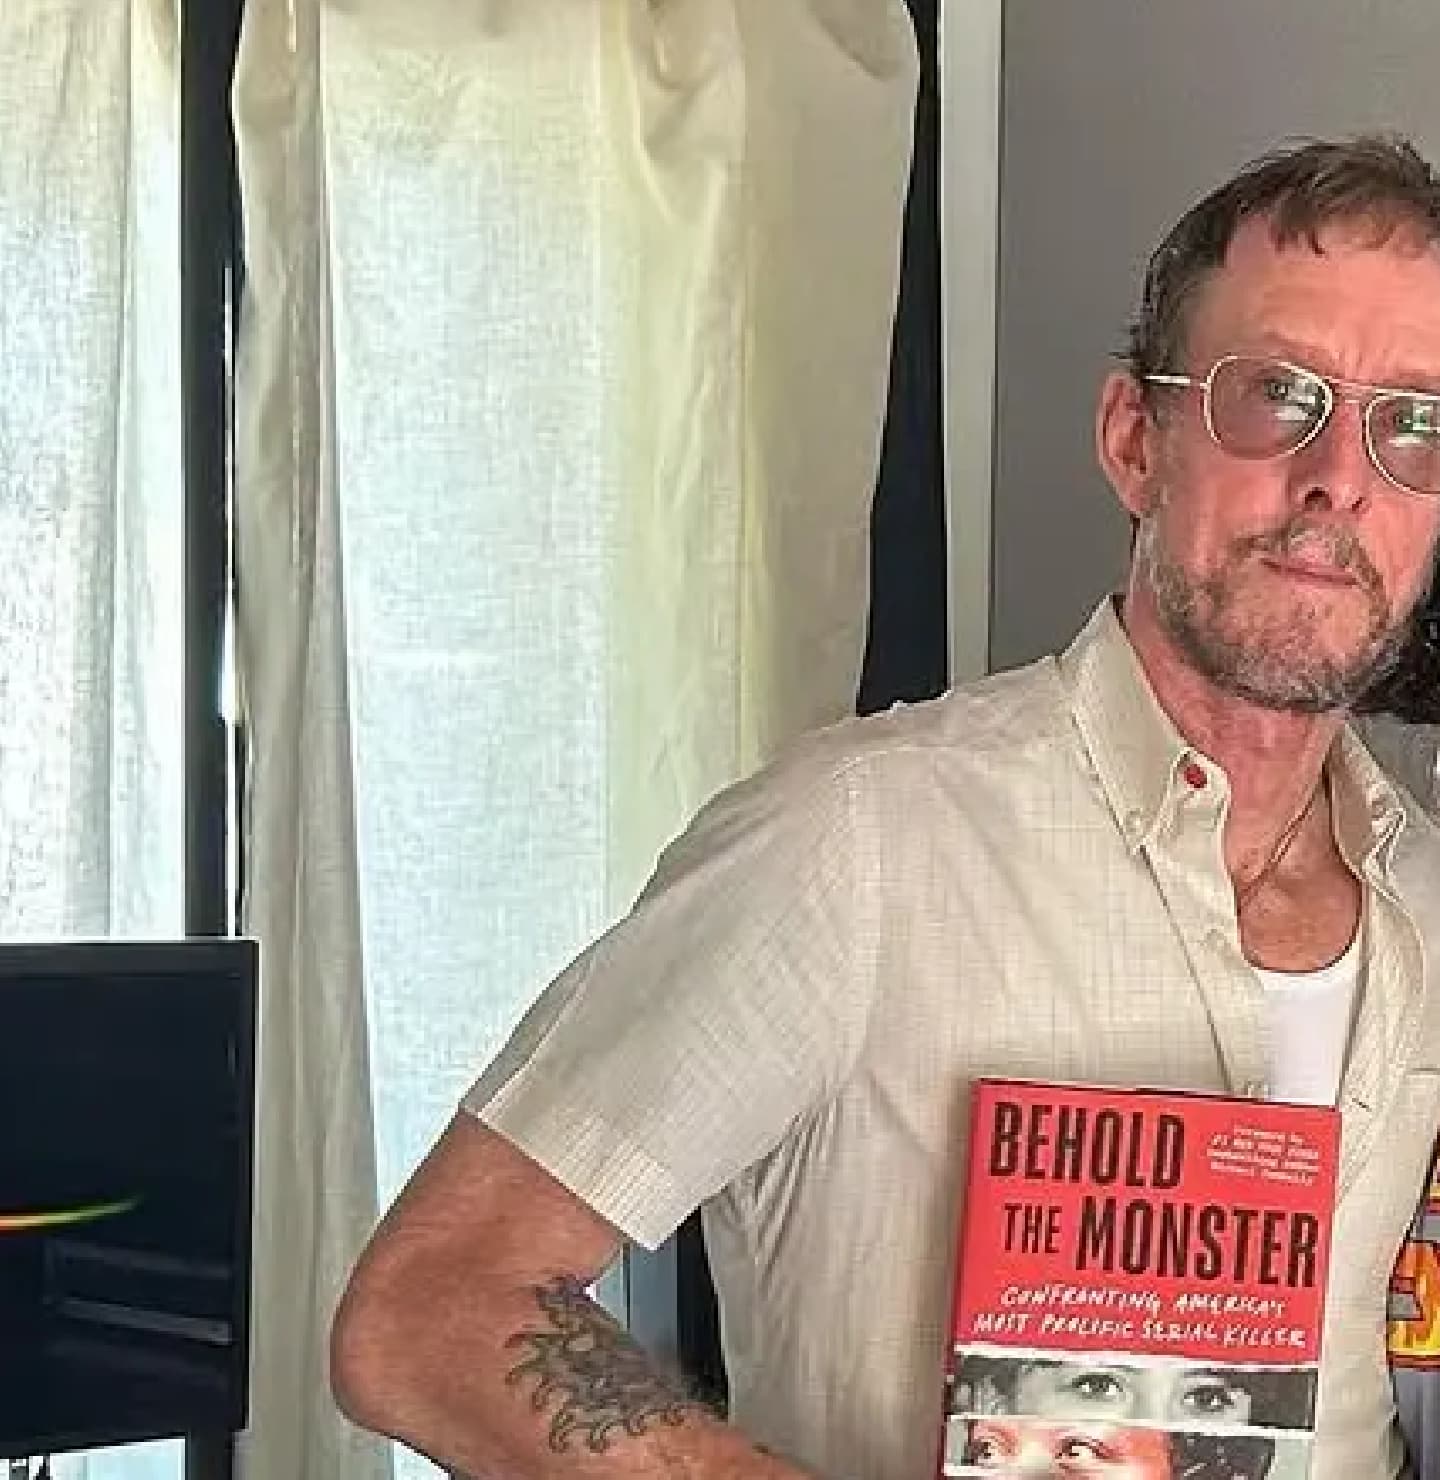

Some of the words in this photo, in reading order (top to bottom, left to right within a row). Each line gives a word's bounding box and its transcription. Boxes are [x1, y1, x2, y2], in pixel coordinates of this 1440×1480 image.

[988, 1101, 1186, 1190] BEHOLD
[1003, 1203, 1063, 1254] THE
[1075, 1195, 1321, 1288] MONSTER
[972, 1312, 1030, 1335] MOST
[1040, 1314, 1135, 1338] PROLIFIC
[1139, 1319, 1218, 1342] SERIAL
[1223, 1323, 1307, 1350] KILLER
[1000, 1283, 1162, 1317] CONFRONTING
[1171, 1291, 1288, 1318] AMERICA'S
